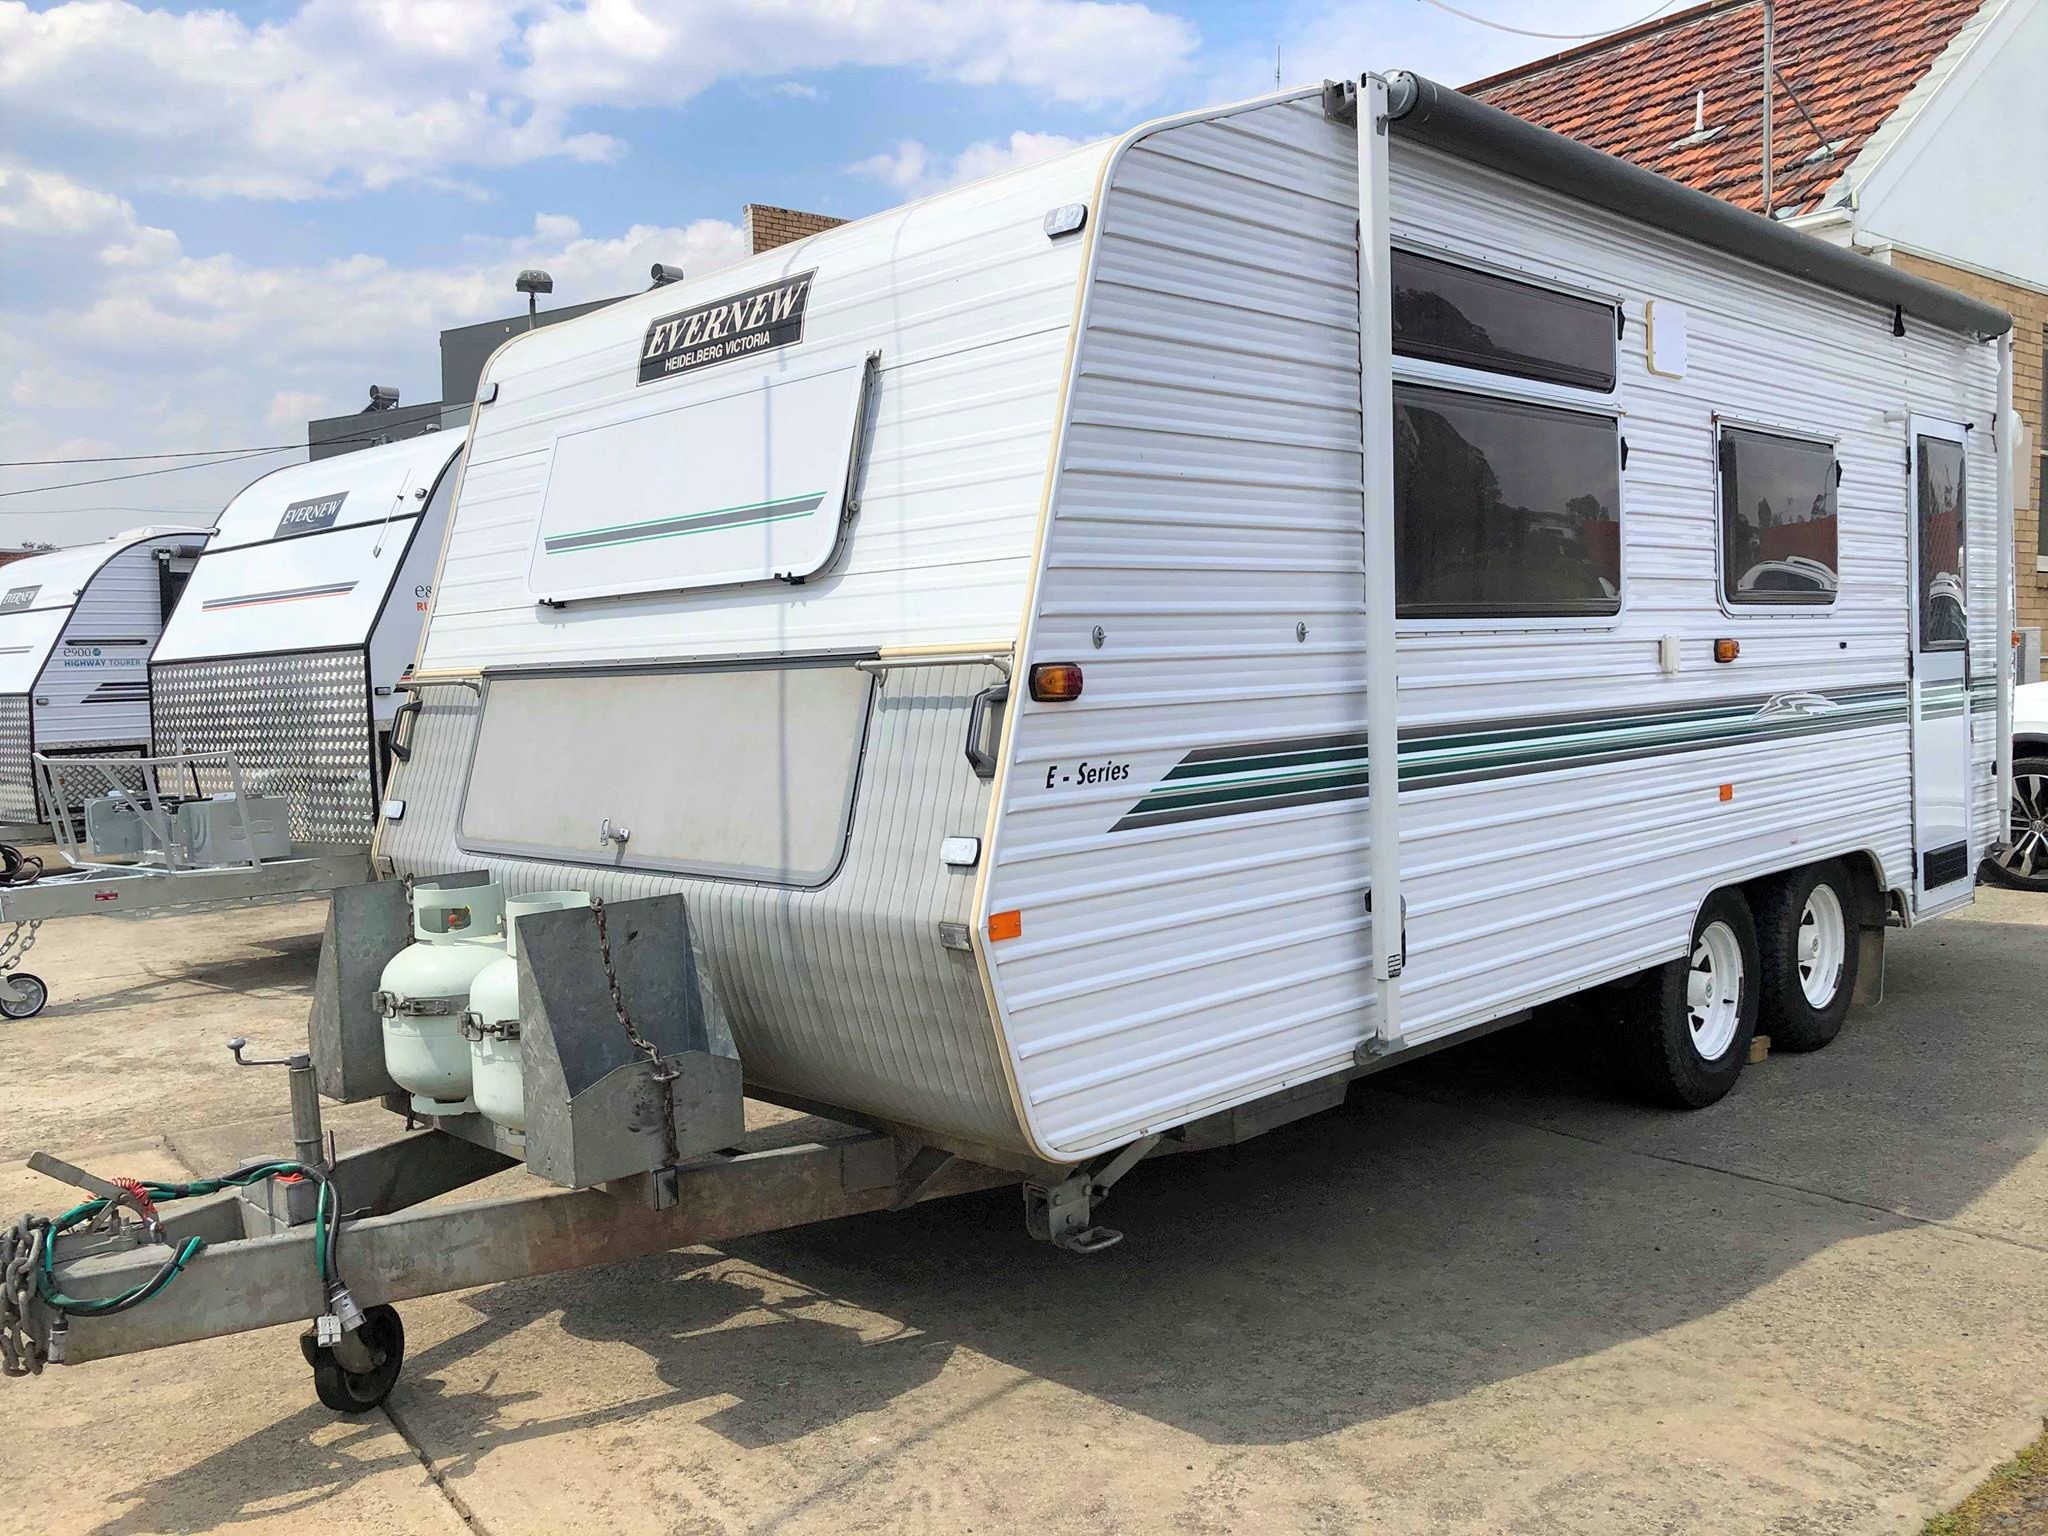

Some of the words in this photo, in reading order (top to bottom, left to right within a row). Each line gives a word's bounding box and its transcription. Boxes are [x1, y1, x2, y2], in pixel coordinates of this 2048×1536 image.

[643, 281, 807, 359] EVERNEW
[664, 346, 723, 372] HEIDELBERG
[725, 331, 770, 355] VICTORIA
[282, 499, 341, 525] EVERNEW
[63, 647, 91, 657] e900
[64, 659, 106, 667] HIGHWAY
[109, 658, 141, 667] TOURER
[1076, 760, 1130, 785] Series
